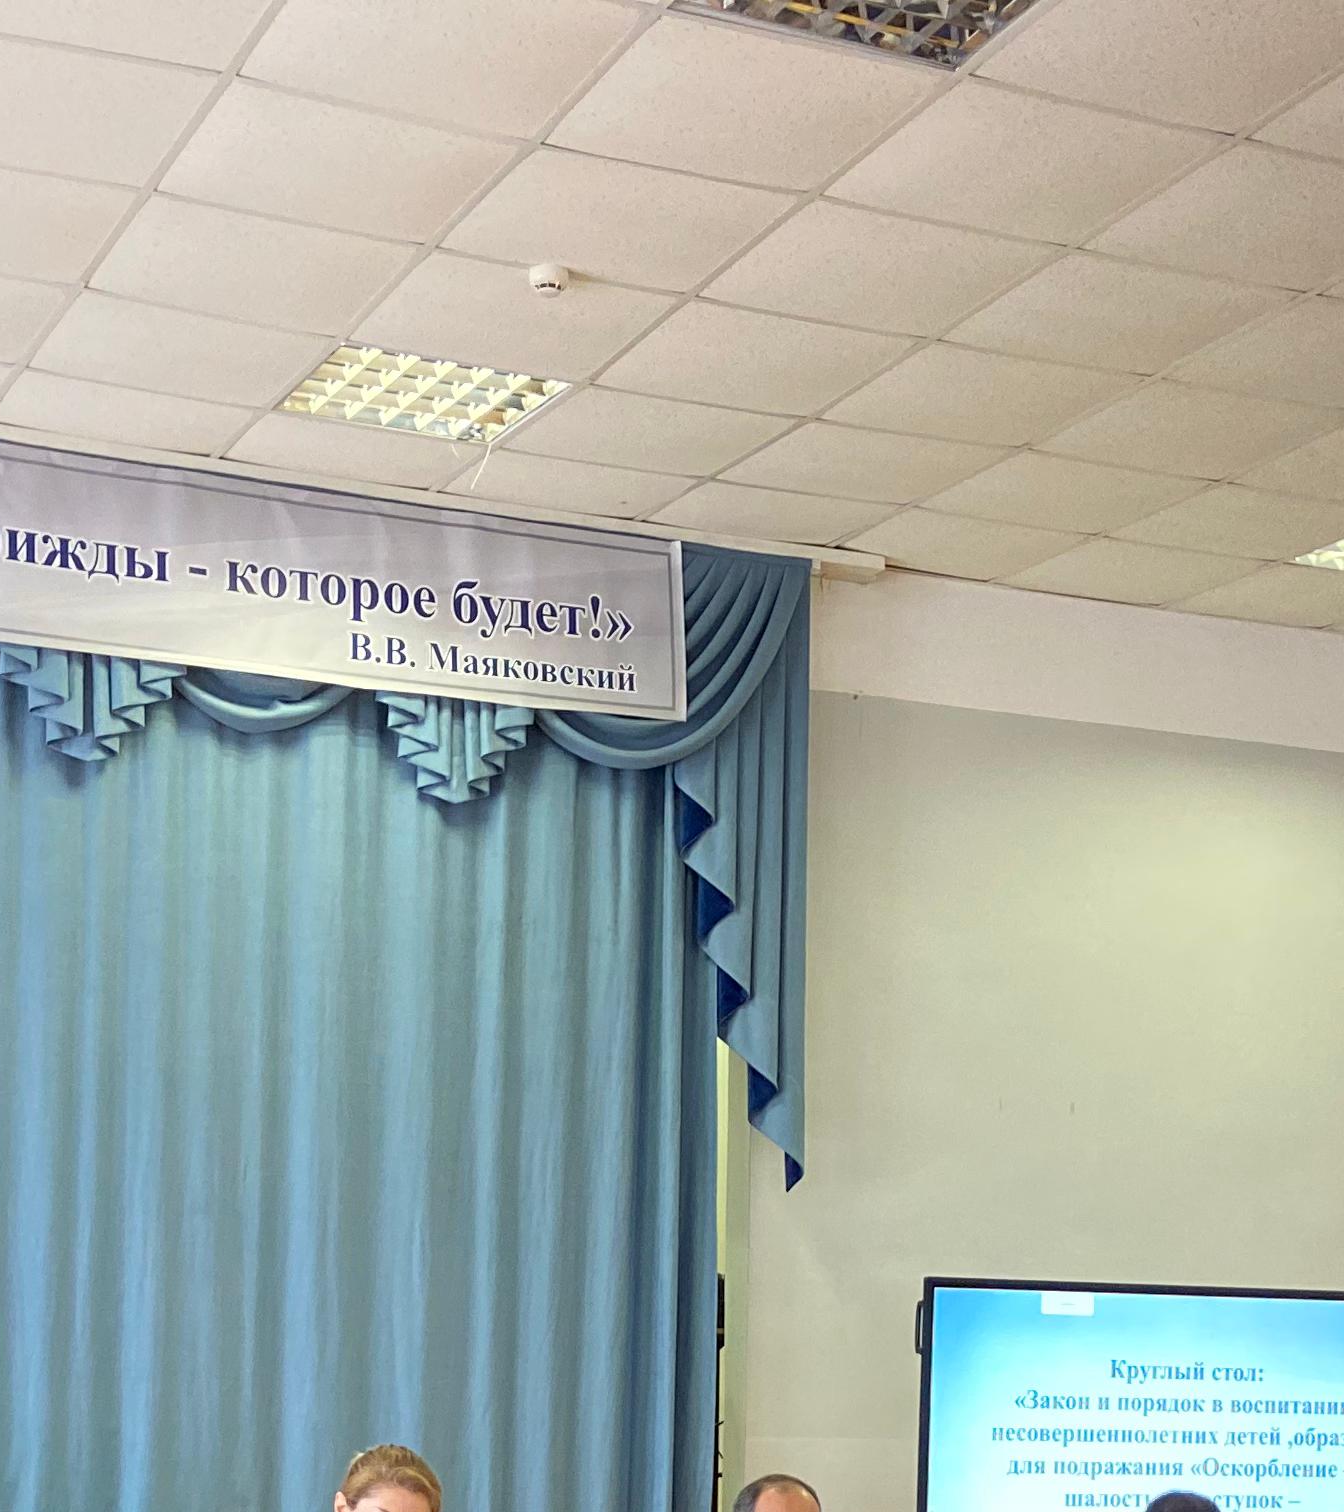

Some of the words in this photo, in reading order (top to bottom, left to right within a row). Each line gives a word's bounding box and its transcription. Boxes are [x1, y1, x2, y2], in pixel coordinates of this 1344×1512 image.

[226, 561, 436, 621] которое
[454, 581, 633, 640] будет!»
[351, 632, 416, 667] В.В.
[428, 642, 637, 692] Маяковский
[1110, 1359, 1204, 1384] Круглый
[1212, 1366, 1264, 1382] стол:
[1015, 1389, 1089, 1410] «Закон
[1098, 1397, 1109, 1410] и
[1118, 1397, 1205, 1416] порядок
[1212, 1399, 1223, 1412] в
[992, 1426, 1218, 1447] несовершеннолетних
[1224, 1427, 1281, 1447] детей
[1006, 1460, 1046, 1475] для
[1054, 1460, 1183, 1480] подражания
[1191, 1457, 1338, 1482] «Оскорбление
